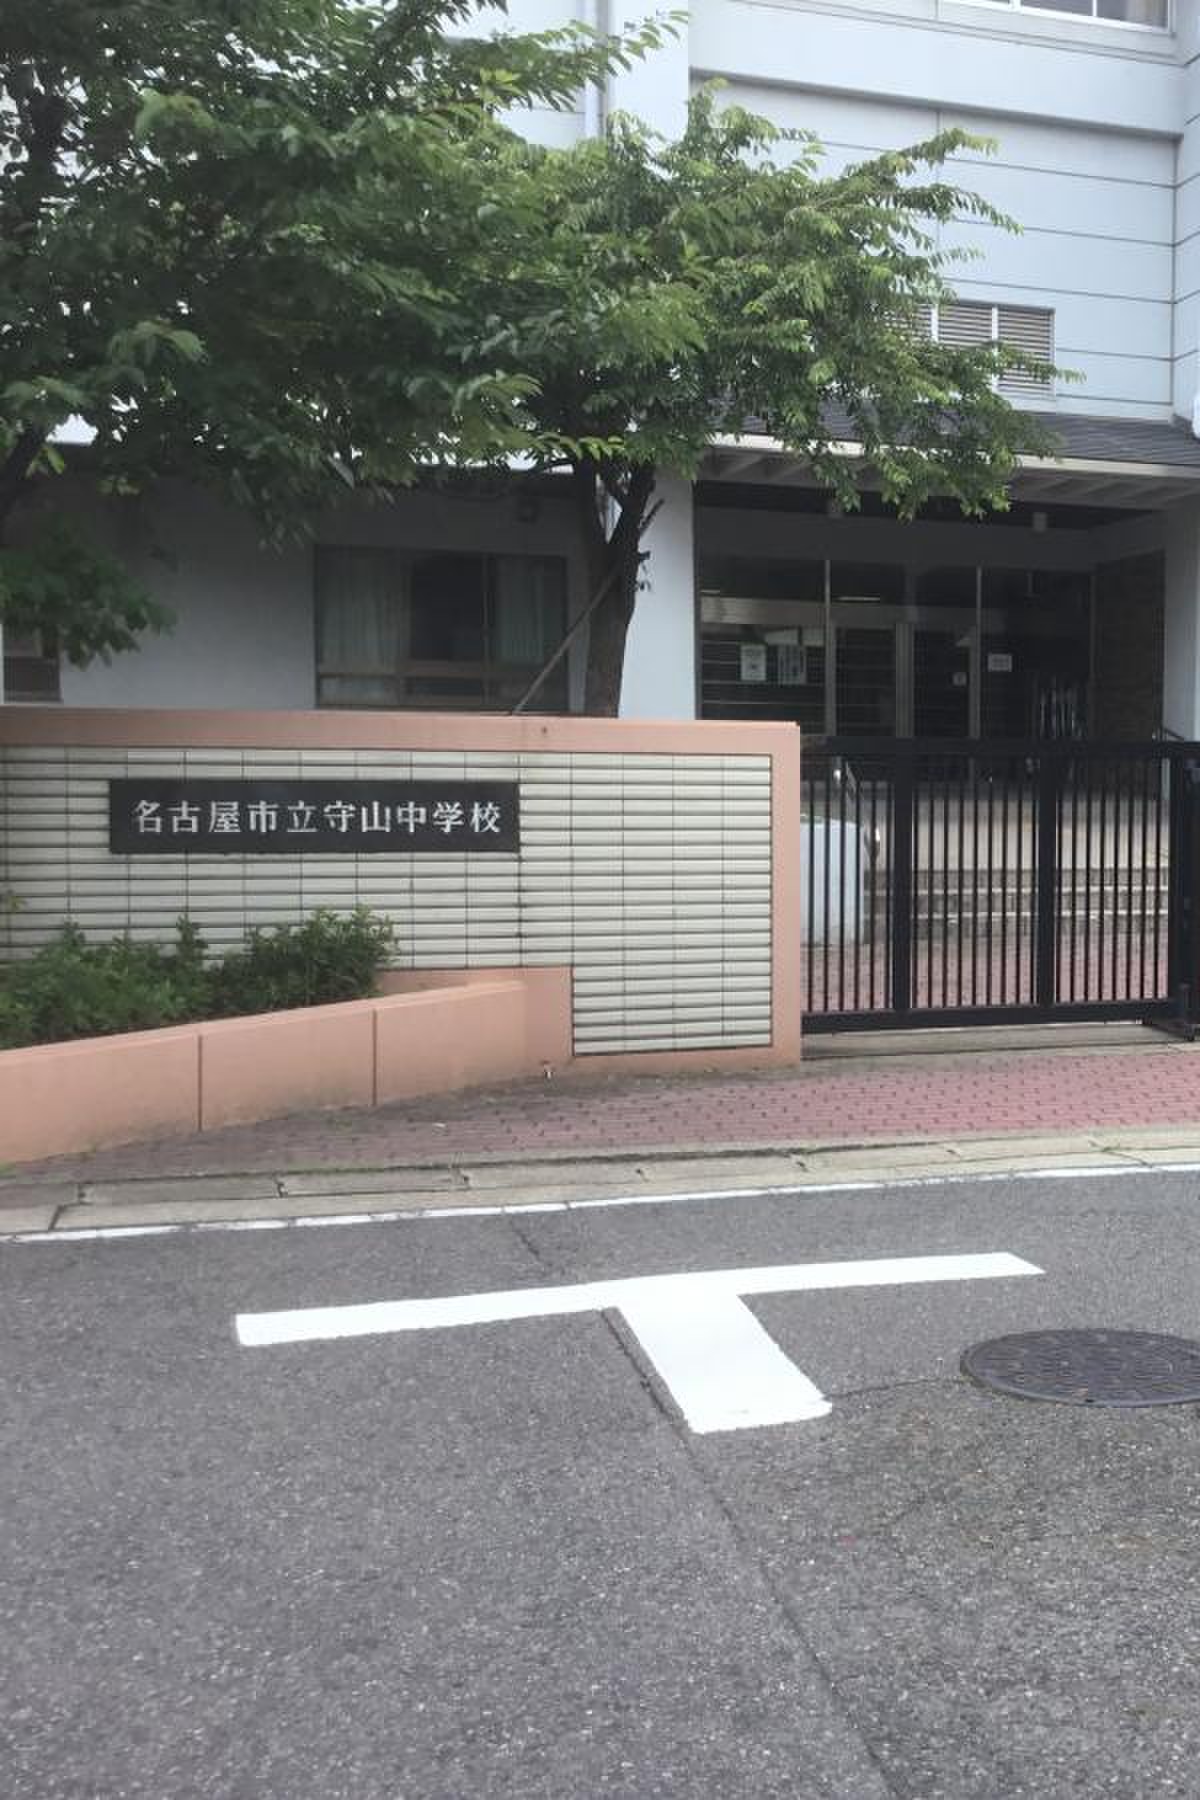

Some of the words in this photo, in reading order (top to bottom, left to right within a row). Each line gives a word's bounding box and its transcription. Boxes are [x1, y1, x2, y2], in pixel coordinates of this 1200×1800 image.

[133, 798, 502, 834] 名古屋市立守山中学校
